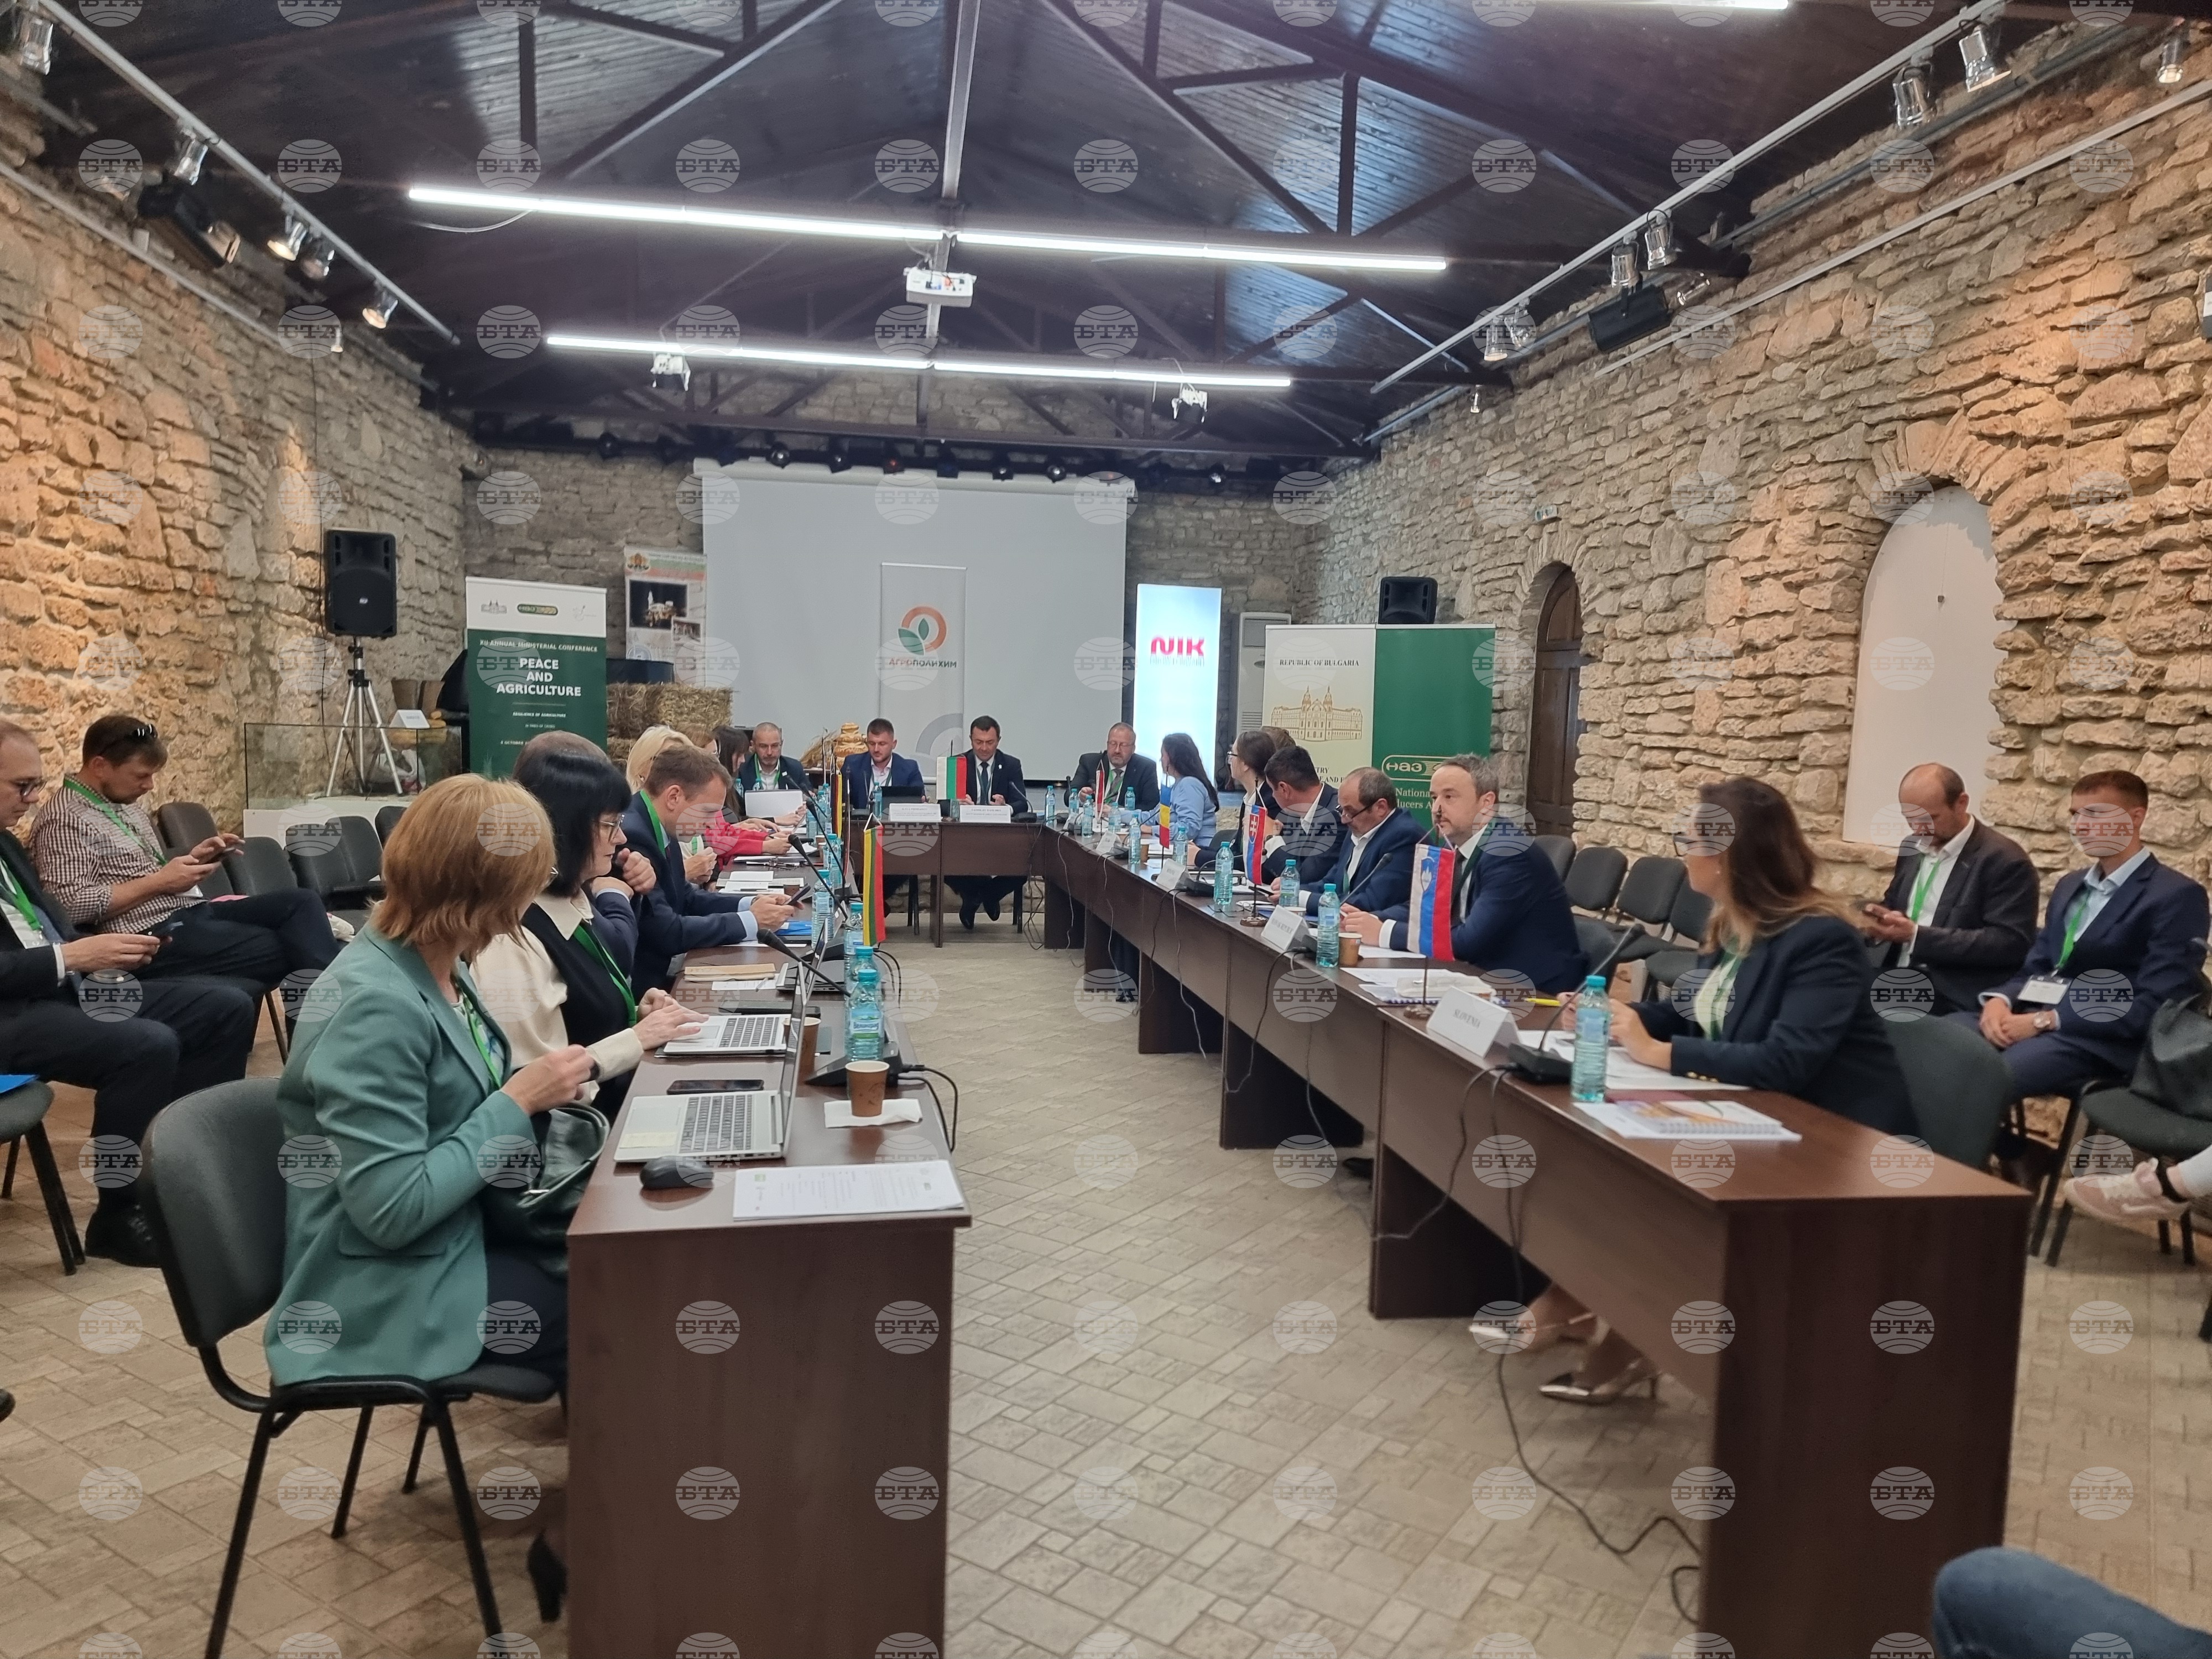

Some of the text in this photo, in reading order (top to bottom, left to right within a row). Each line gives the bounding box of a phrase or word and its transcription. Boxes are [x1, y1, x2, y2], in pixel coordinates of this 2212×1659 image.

[518, 641, 557, 650] MINISTERIAL
[558, 644, 597, 652] CONFERENCE
[1151, 636, 1204, 656] NIK
[519, 658, 559, 670] PEACE
[889, 658, 957, 668] АГРОПОЛИХИМ
[526, 671, 553, 682] AND
[496, 683, 581, 697] AGRICULTURE
[1395, 788, 1431, 797] Nationa
